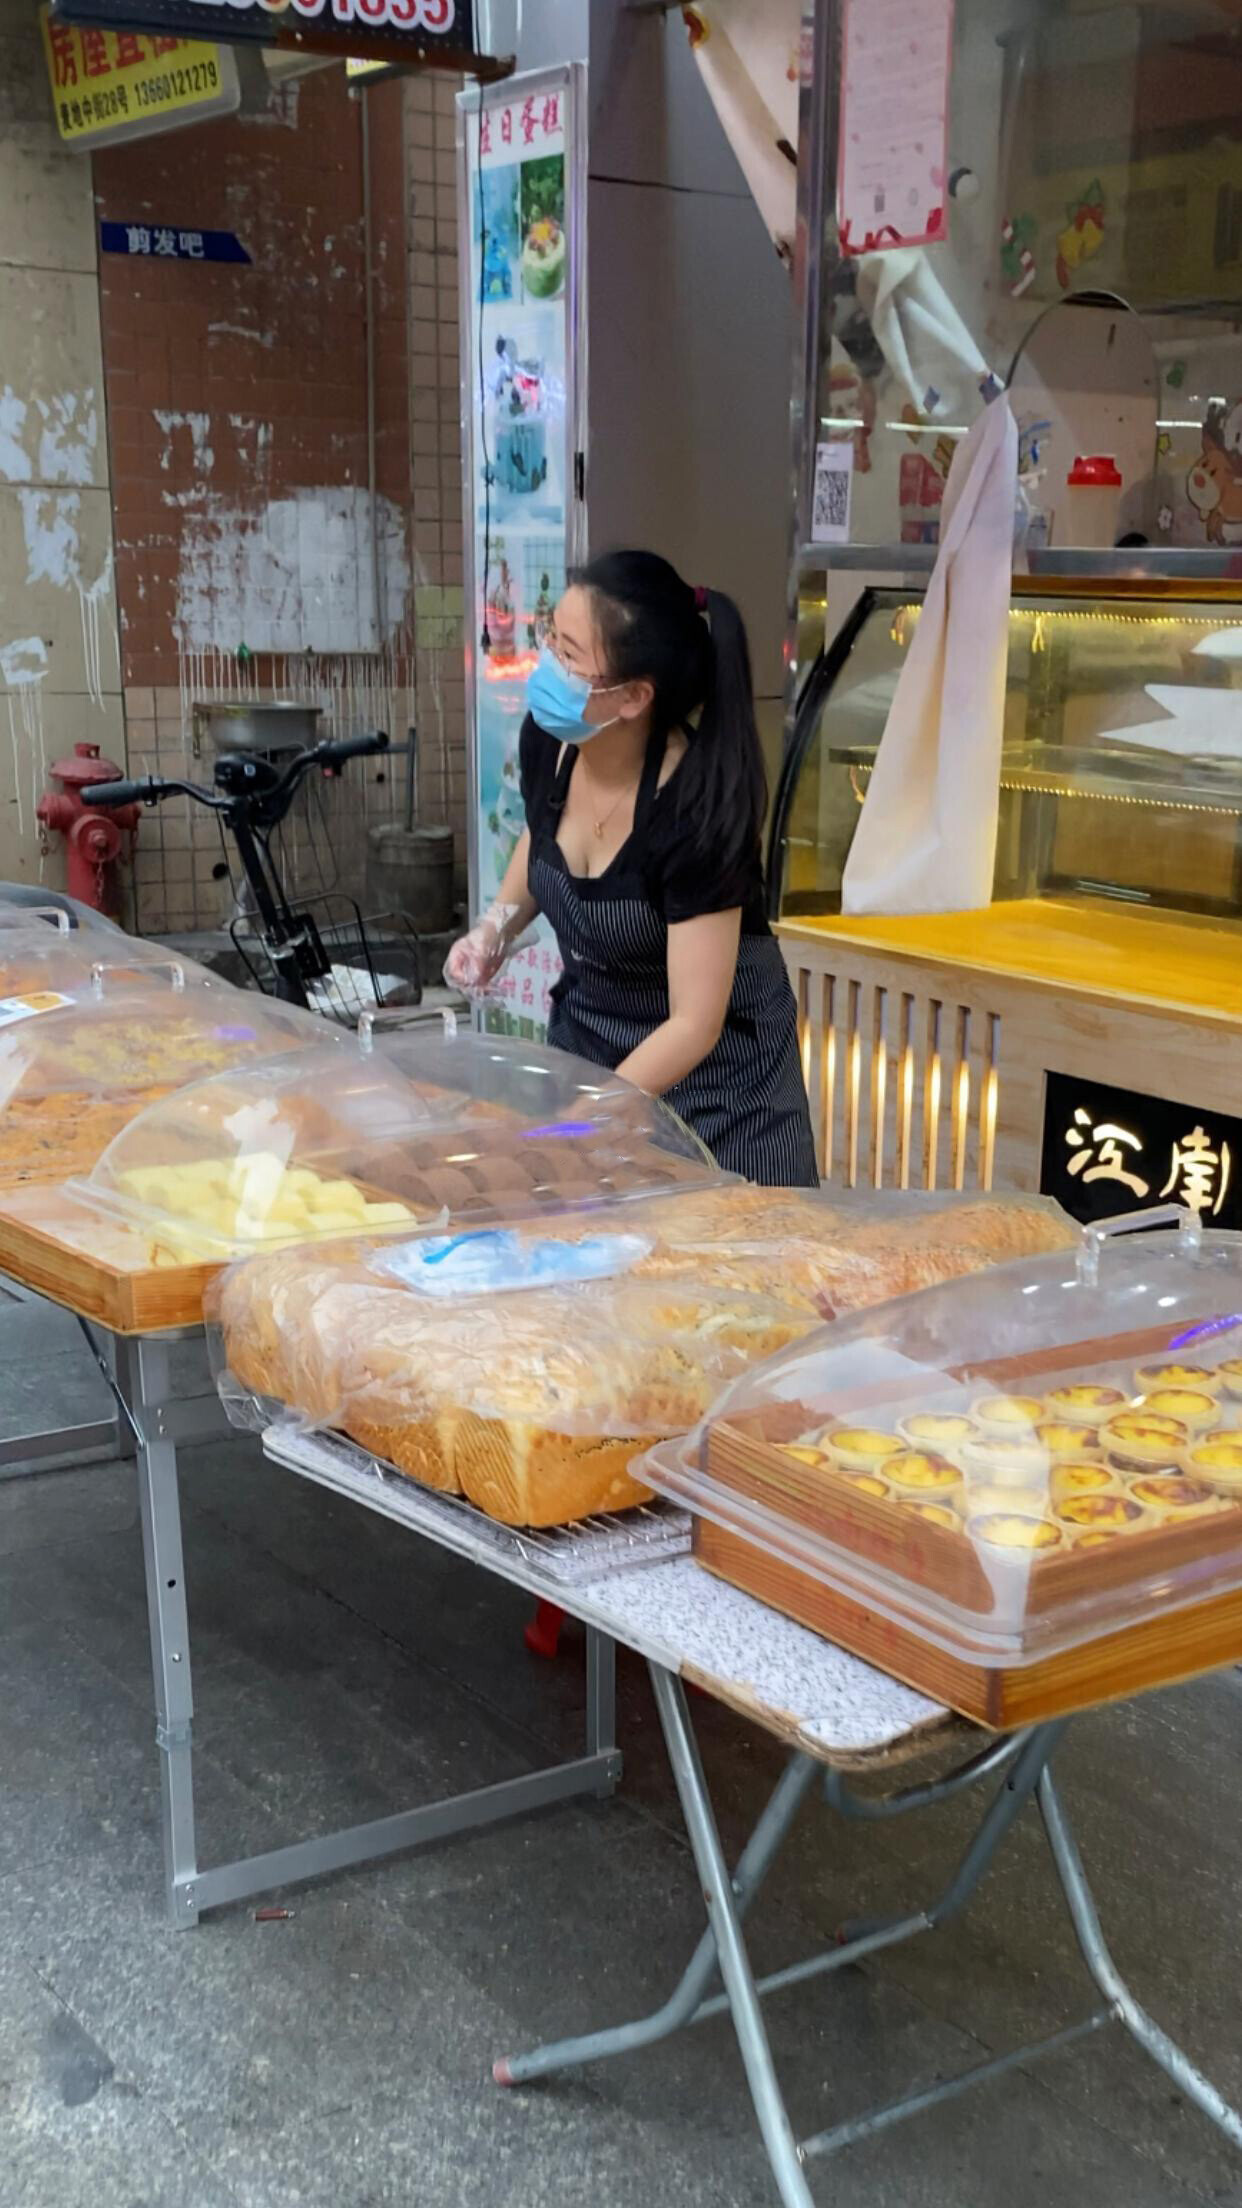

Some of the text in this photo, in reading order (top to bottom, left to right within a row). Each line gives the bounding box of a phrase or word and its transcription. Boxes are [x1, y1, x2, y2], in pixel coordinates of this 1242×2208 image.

[134, 60, 217, 107] 13660121279
[126, 226, 205, 258] 剪发吧
